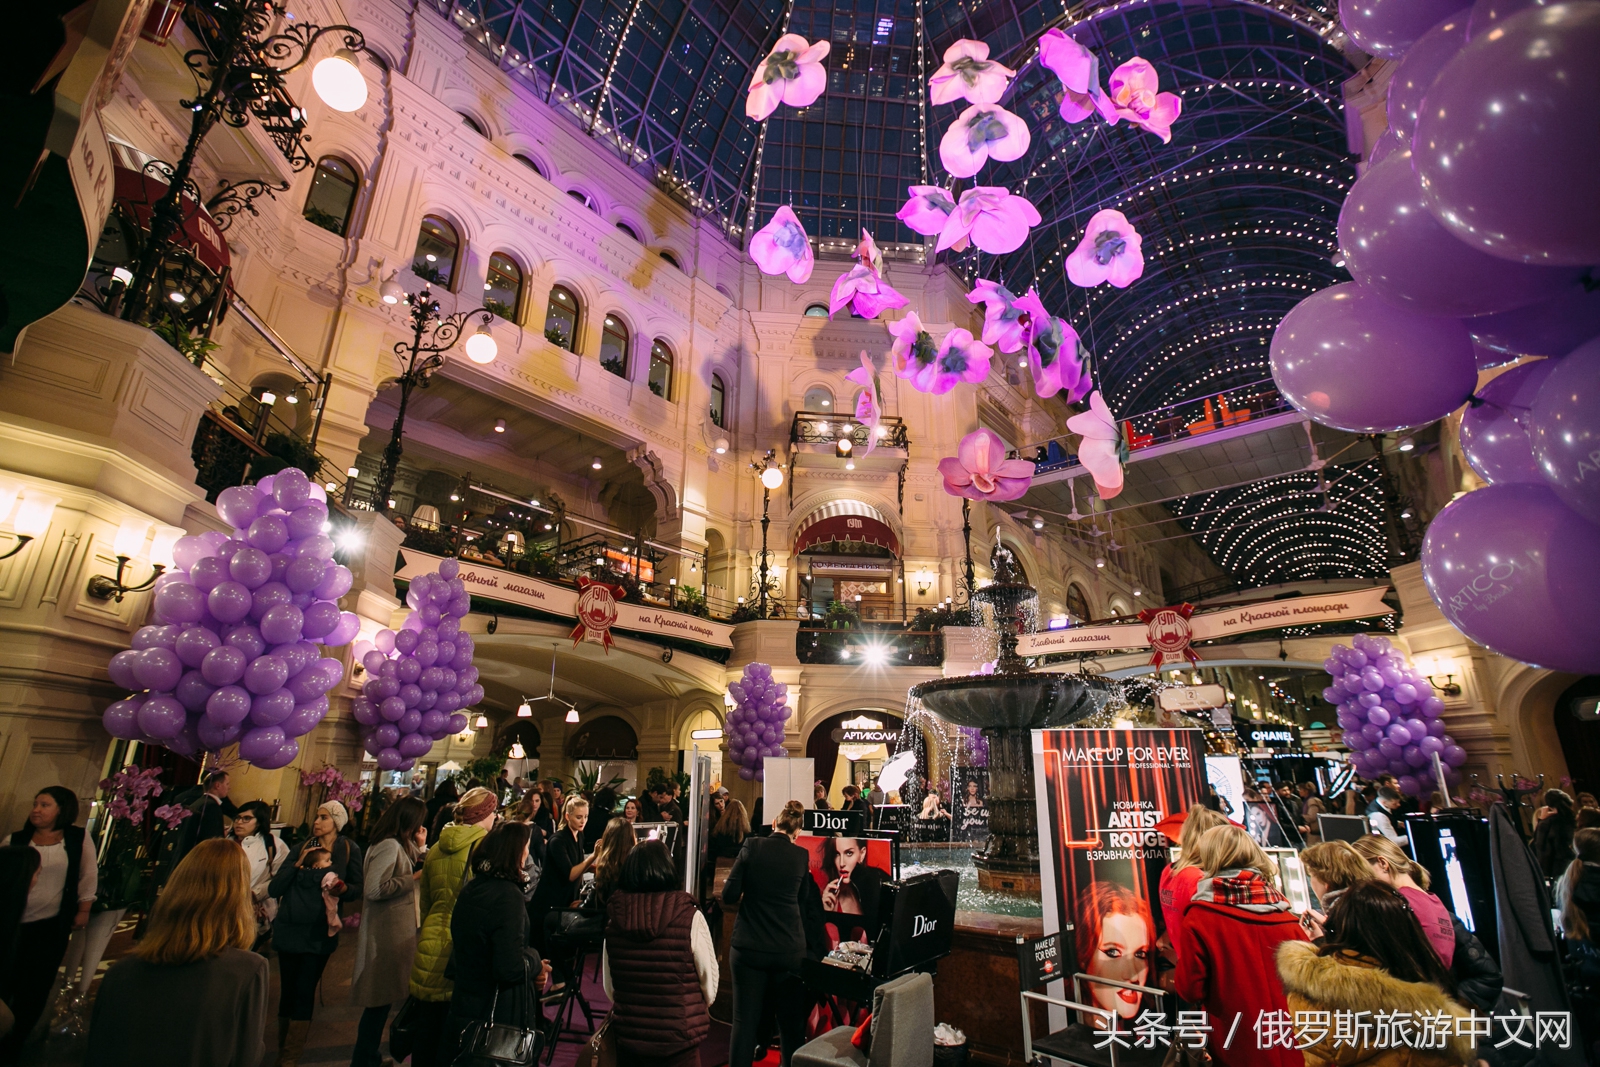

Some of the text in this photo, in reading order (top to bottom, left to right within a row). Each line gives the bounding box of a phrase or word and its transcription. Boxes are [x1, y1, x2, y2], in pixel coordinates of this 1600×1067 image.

[846, 518, 863, 528] ГУМ
[457, 572, 545, 600] авный магазин
[591, 586, 609, 602] ГУМ
[1156, 611, 1177, 626] ГУМ
[1223, 602, 1350, 627] на Красной площади
[638, 614, 714, 638] на Красной площади
[588, 630, 602, 639] GUM
[1030, 633, 1111, 648] Главный магазин
[1165, 653, 1181, 661] GUM
[1188, 691, 1195, 699] 2
[843, 731, 897, 741] АРТИКОЛИ
[1251, 730, 1295, 742] CHANEL
[1062, 746, 1190, 762] MAKE UP FOR EVER
[1113, 801, 1154, 809] НОВИНКА
[812, 812, 849, 830] Dior
[1108, 810, 1163, 828] ARTIST
[1109, 832, 1167, 848] ROUGE
[1086, 850, 1134, 861] ВЗРЫВНАЯ
[1135, 849, 1164, 859] СИЛА
[911, 914, 938, 938] Dior
[1035, 937, 1055, 951] MAKE UP
[1035, 947, 1057, 961] FOR EVER
